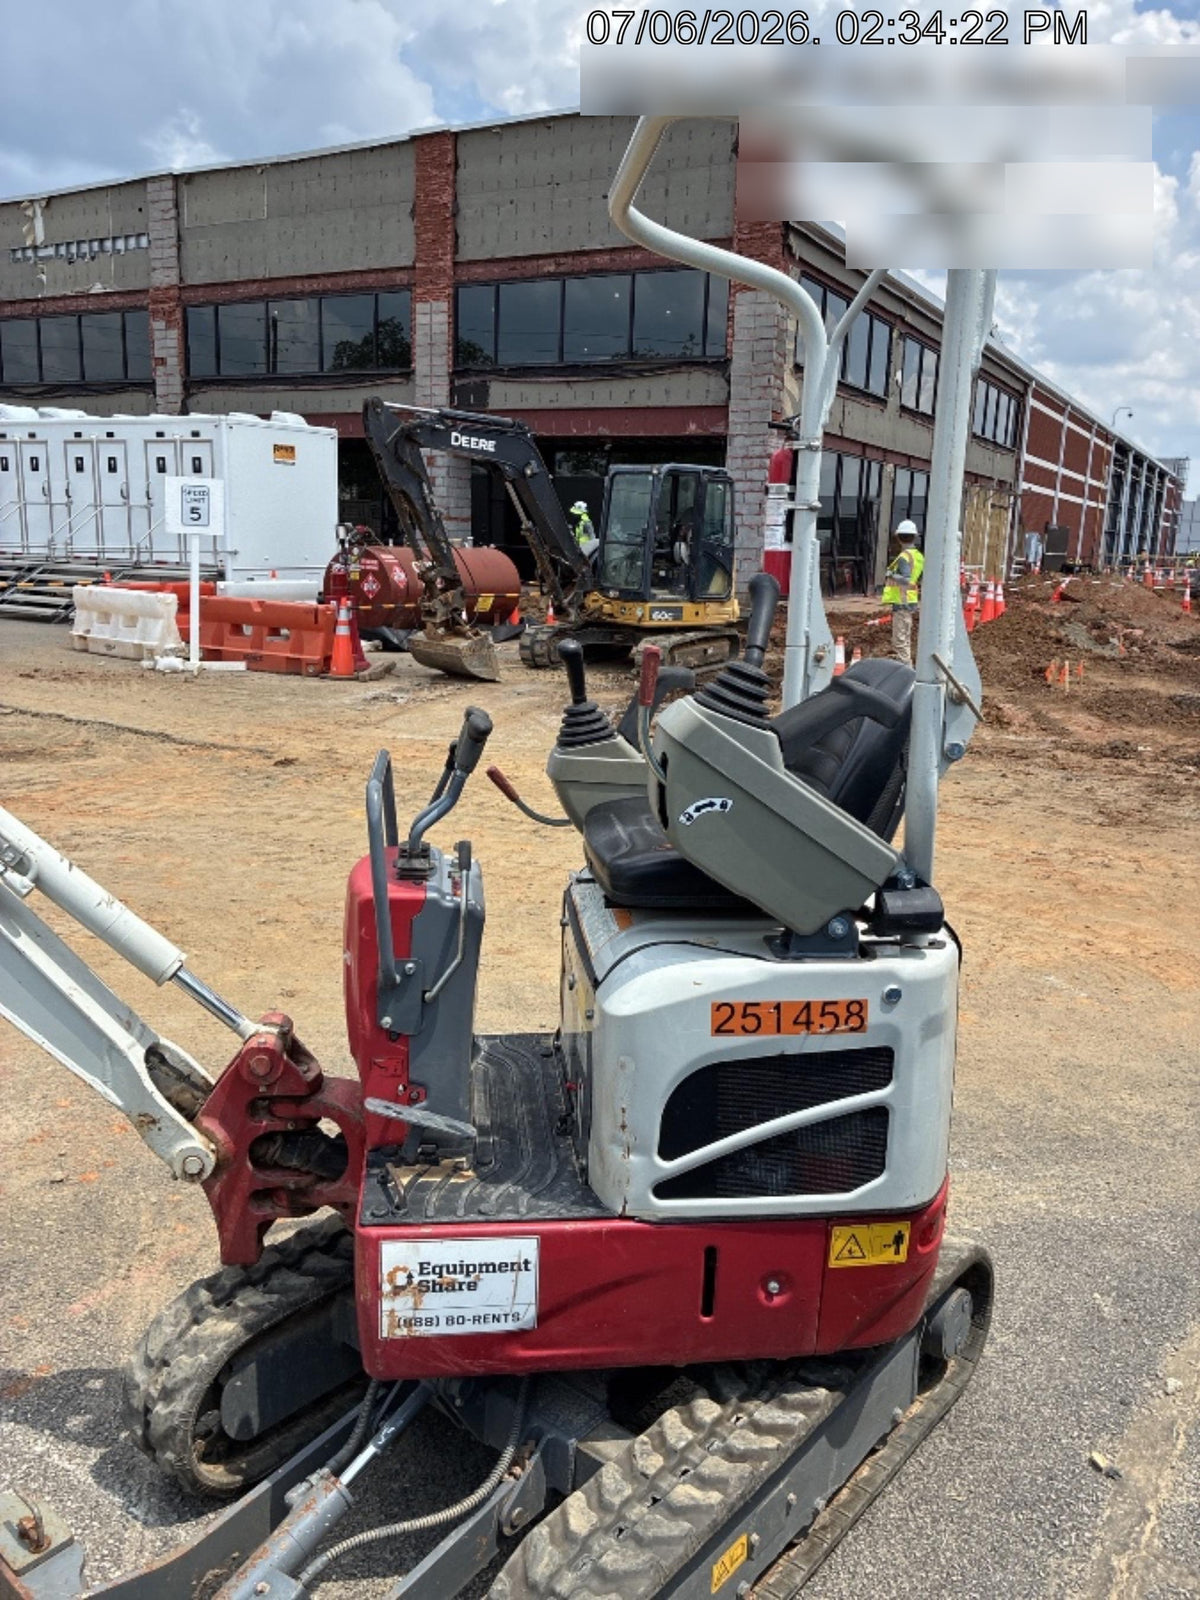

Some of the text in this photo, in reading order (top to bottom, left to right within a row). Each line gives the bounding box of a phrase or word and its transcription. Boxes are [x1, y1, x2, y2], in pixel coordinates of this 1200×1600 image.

[451, 431, 496, 452] DEERE
[190, 506, 202, 522] 5
[714, 1000, 865, 1034] 251458
[418, 1258, 532, 1278] Equipment
[418, 1279, 478, 1294] Share
